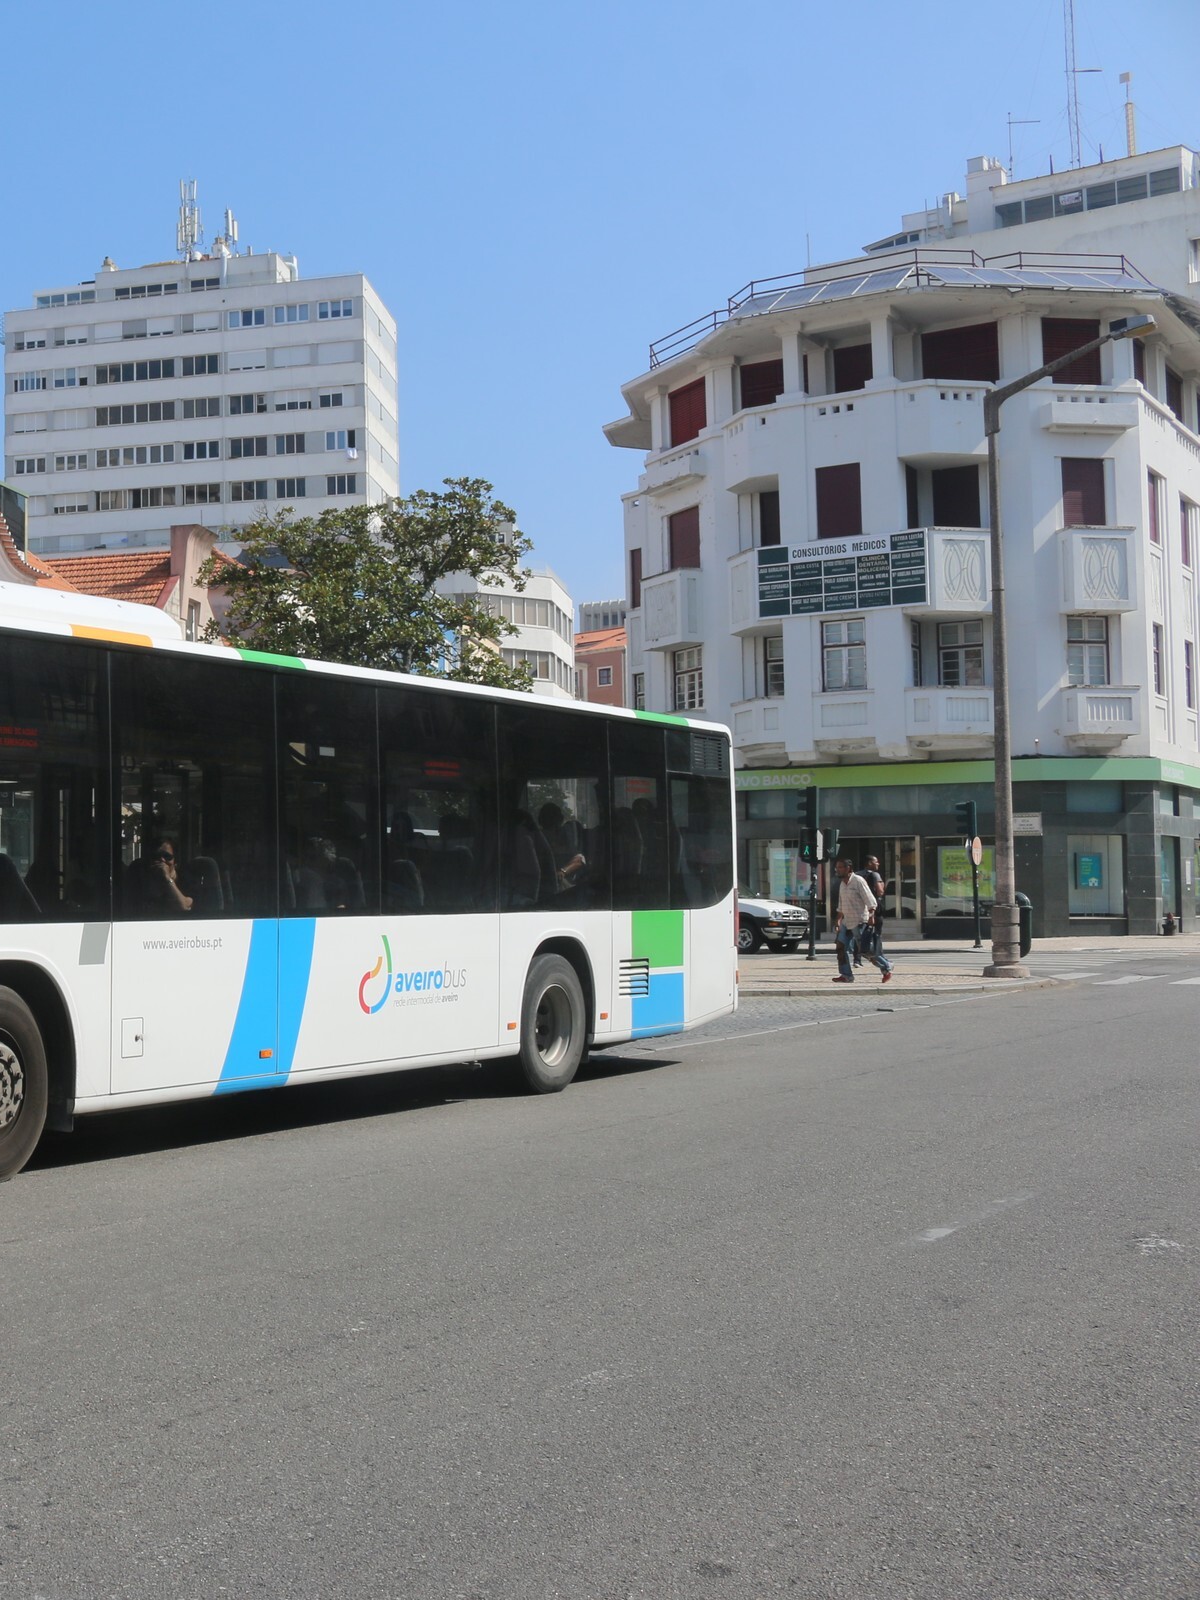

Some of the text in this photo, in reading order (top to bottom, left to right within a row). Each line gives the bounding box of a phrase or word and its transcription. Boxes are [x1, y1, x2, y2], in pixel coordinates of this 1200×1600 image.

[792, 543, 847, 558] CONSULTÓRIOS
[852, 539, 886, 552] MÉDICOS
[735, 774, 811, 787] OVO BANCO
[142, 935, 223, 951] www.aveirobus.pt
[394, 960, 467, 993] aveirobus
